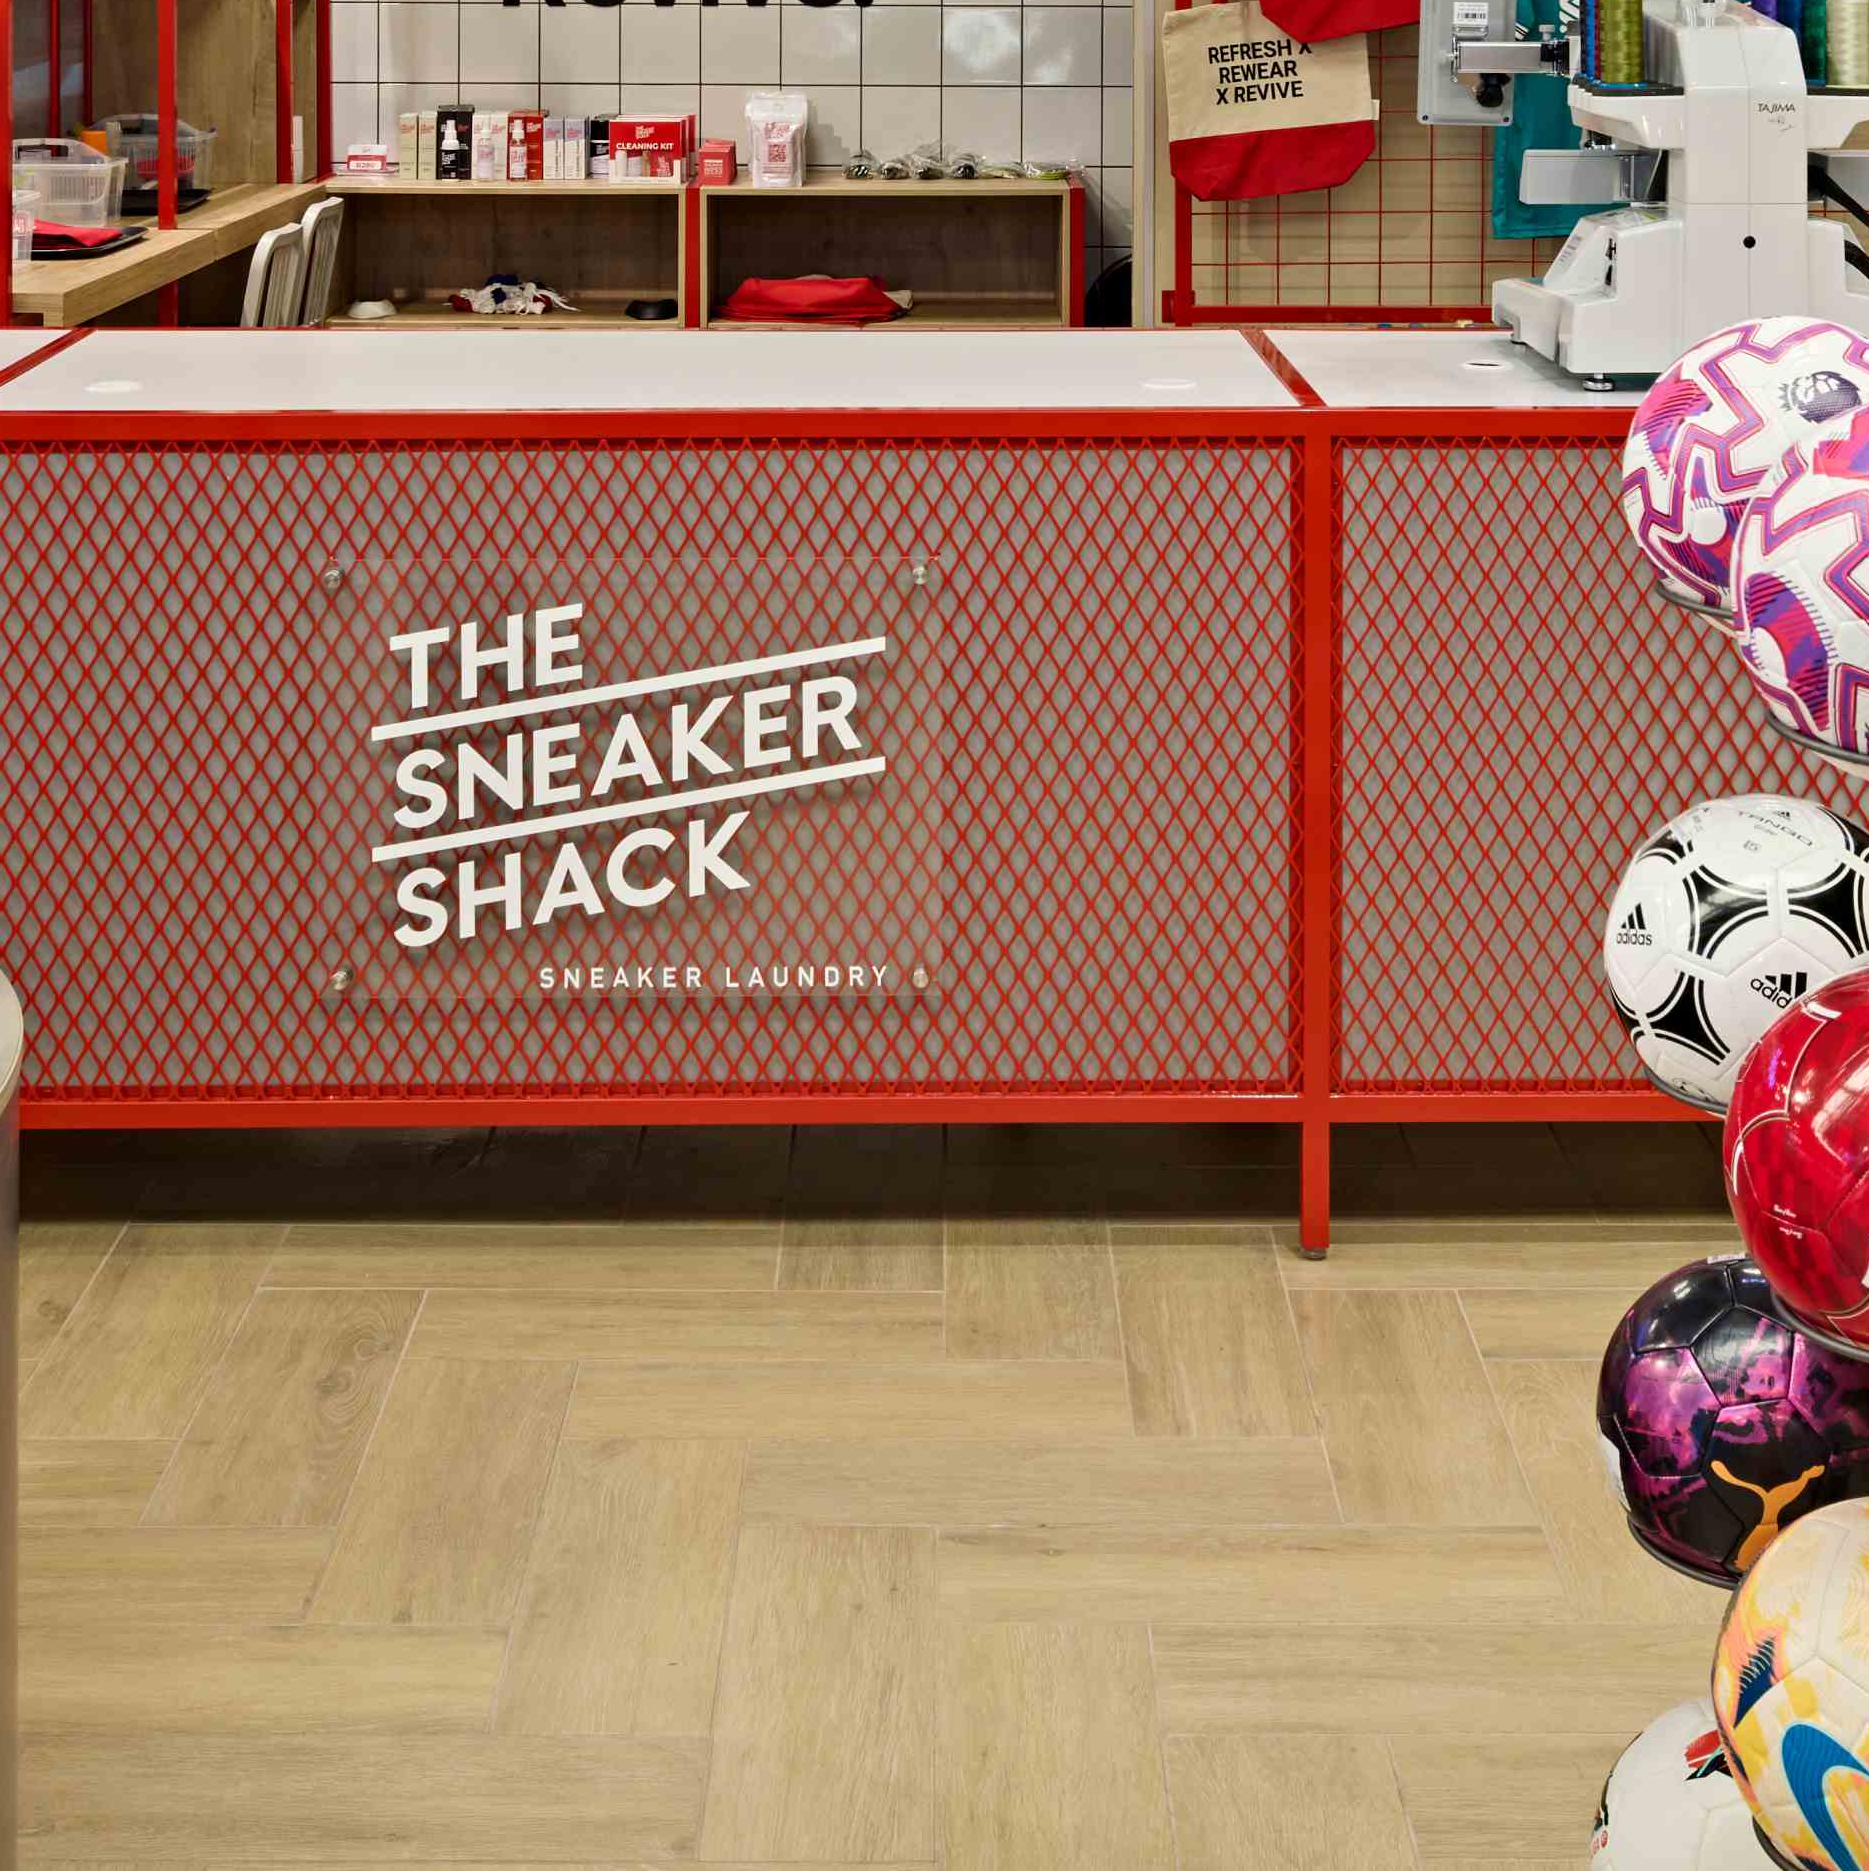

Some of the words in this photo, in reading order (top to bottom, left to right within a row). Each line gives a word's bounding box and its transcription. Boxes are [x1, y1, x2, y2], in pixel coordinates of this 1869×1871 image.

[1208, 39, 1292, 64] REFRESH
[1219, 60, 1298, 84] REWEAR
[1216, 88, 1228, 105] X
[1234, 80, 1304, 103] REVIVE
[1758, 103, 1795, 114] TAJIMA
[616, 142, 659, 150] CLEANING
[660, 142, 675, 150] KIT
[390, 603, 583, 709] THE
[394, 675, 862, 828] SNEAKER
[394, 811, 750, 947] SHACK
[1616, 929, 1652, 946] adidas
[540, 966, 702, 989] SNEAKER
[726, 965, 888, 988] LAUNDRY
